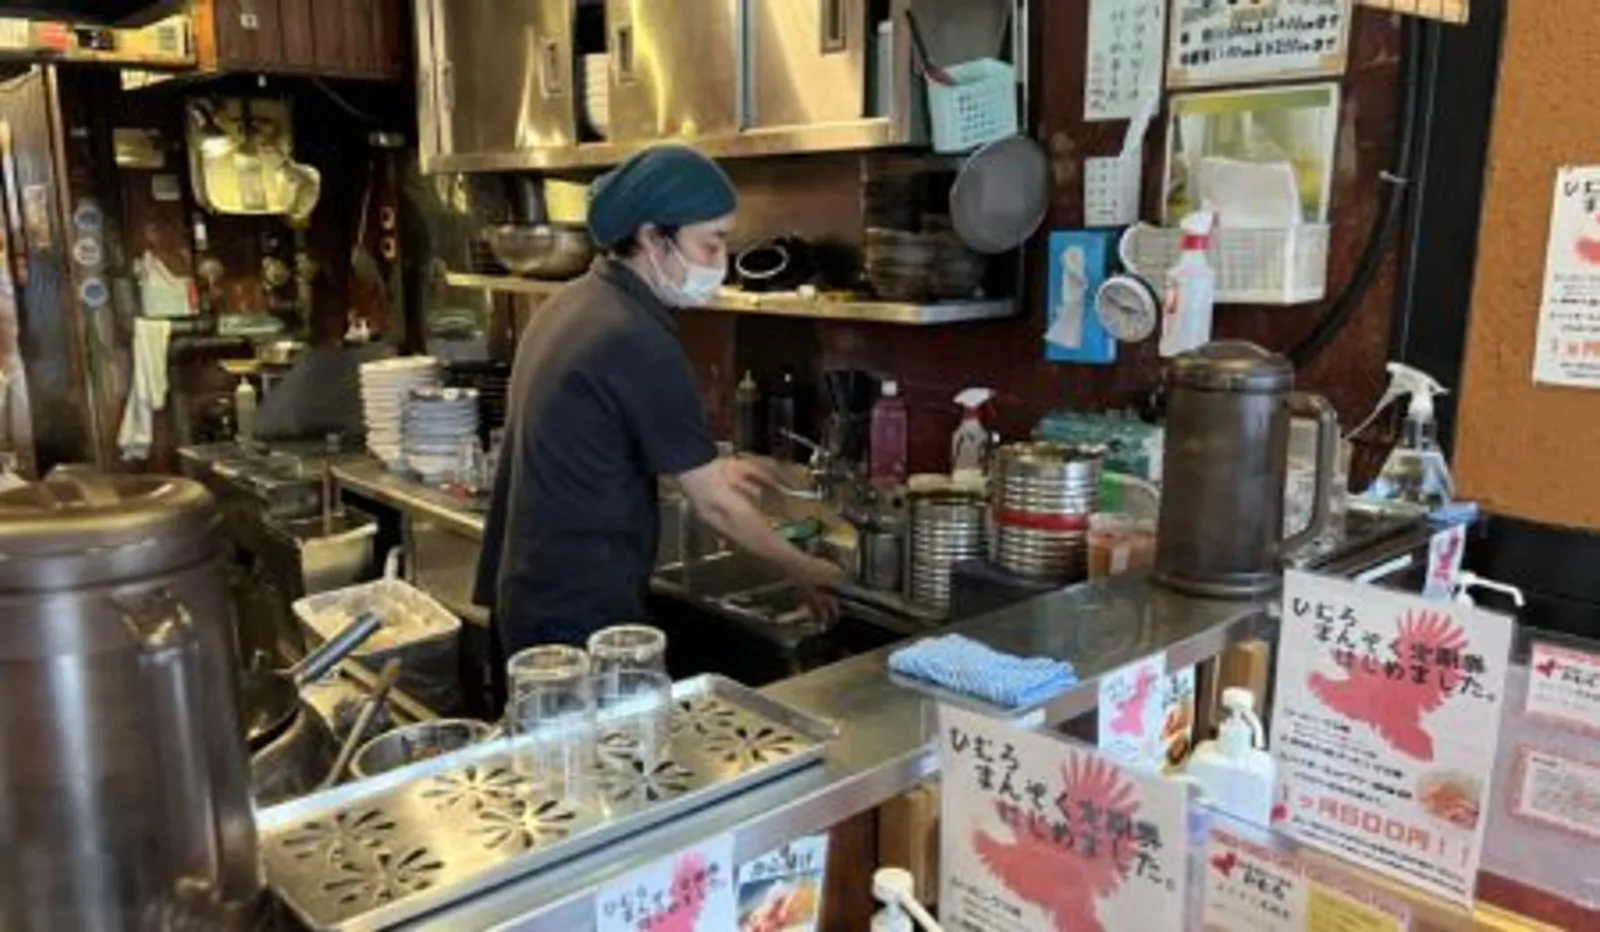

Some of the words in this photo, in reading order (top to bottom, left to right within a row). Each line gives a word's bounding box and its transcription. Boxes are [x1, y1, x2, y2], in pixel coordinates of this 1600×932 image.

[1293, 598, 1355, 627] ひむろ
[1315, 622, 1485, 673] まんぞく定期券
[949, 726, 1020, 771] ひむろ
[974, 764, 1163, 848] まんぞく定期券
